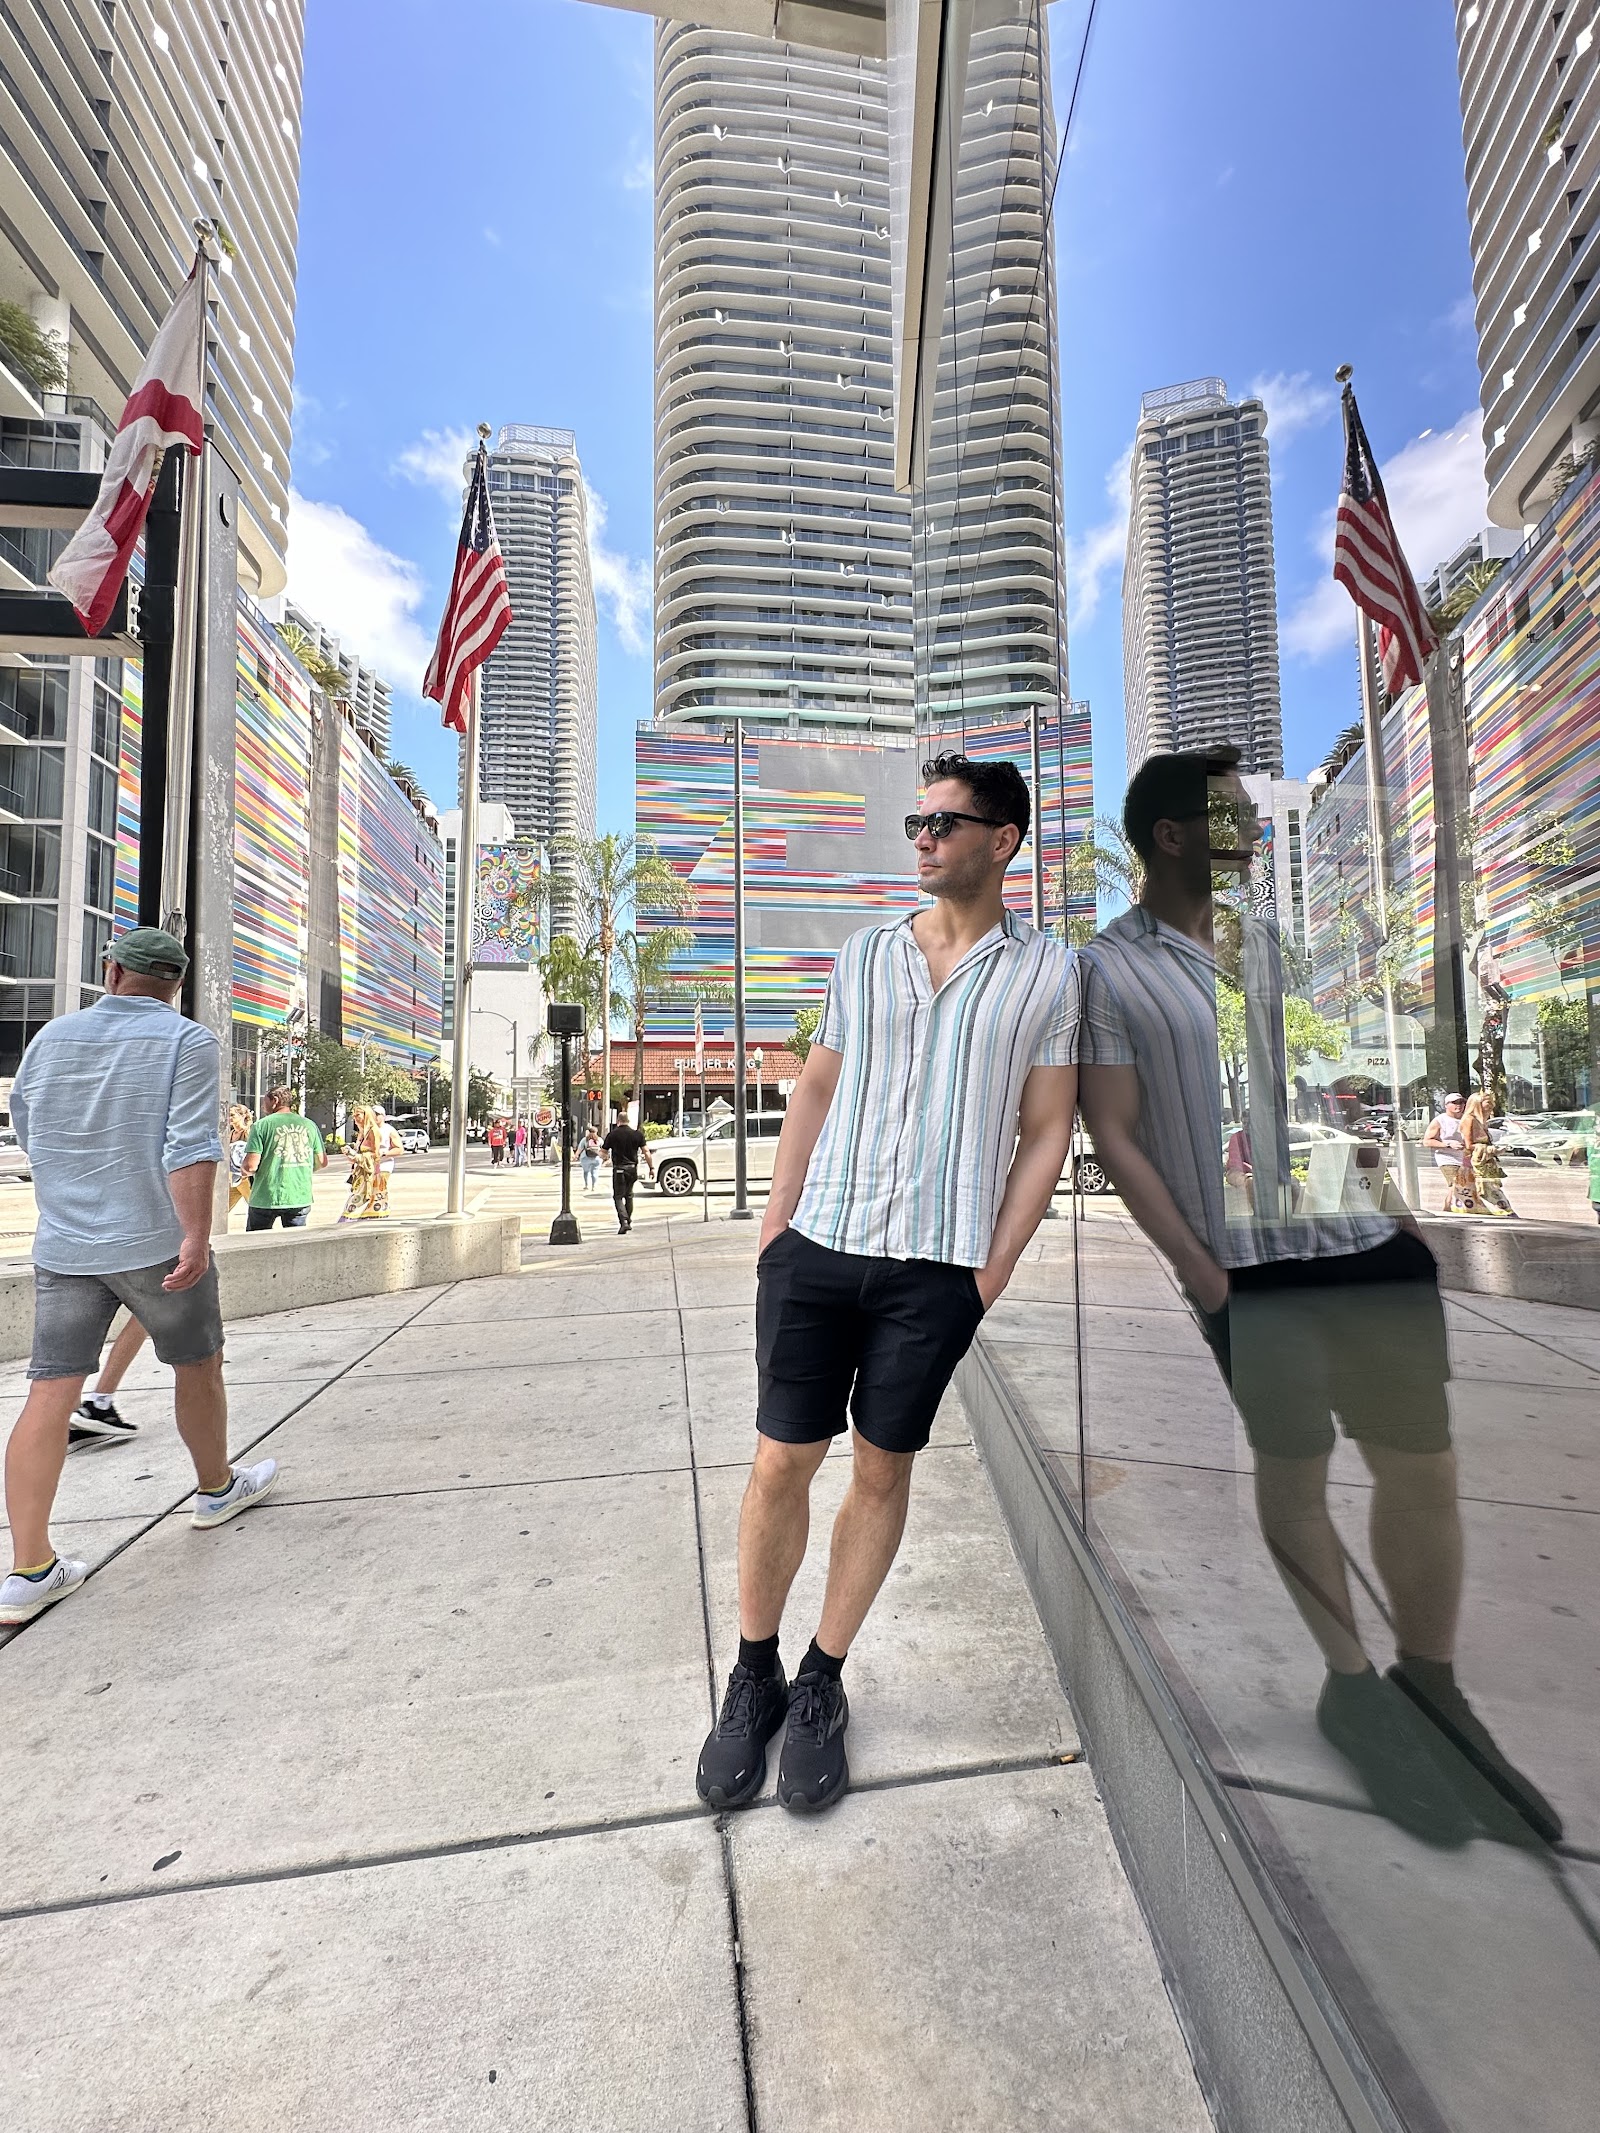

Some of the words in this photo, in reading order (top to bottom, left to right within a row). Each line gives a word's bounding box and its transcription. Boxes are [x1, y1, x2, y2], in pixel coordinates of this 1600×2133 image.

[674, 1058, 721, 1069] BURER
[727, 1058, 756, 1069] KG
[1367, 1057, 1391, 1066] PIZZA
